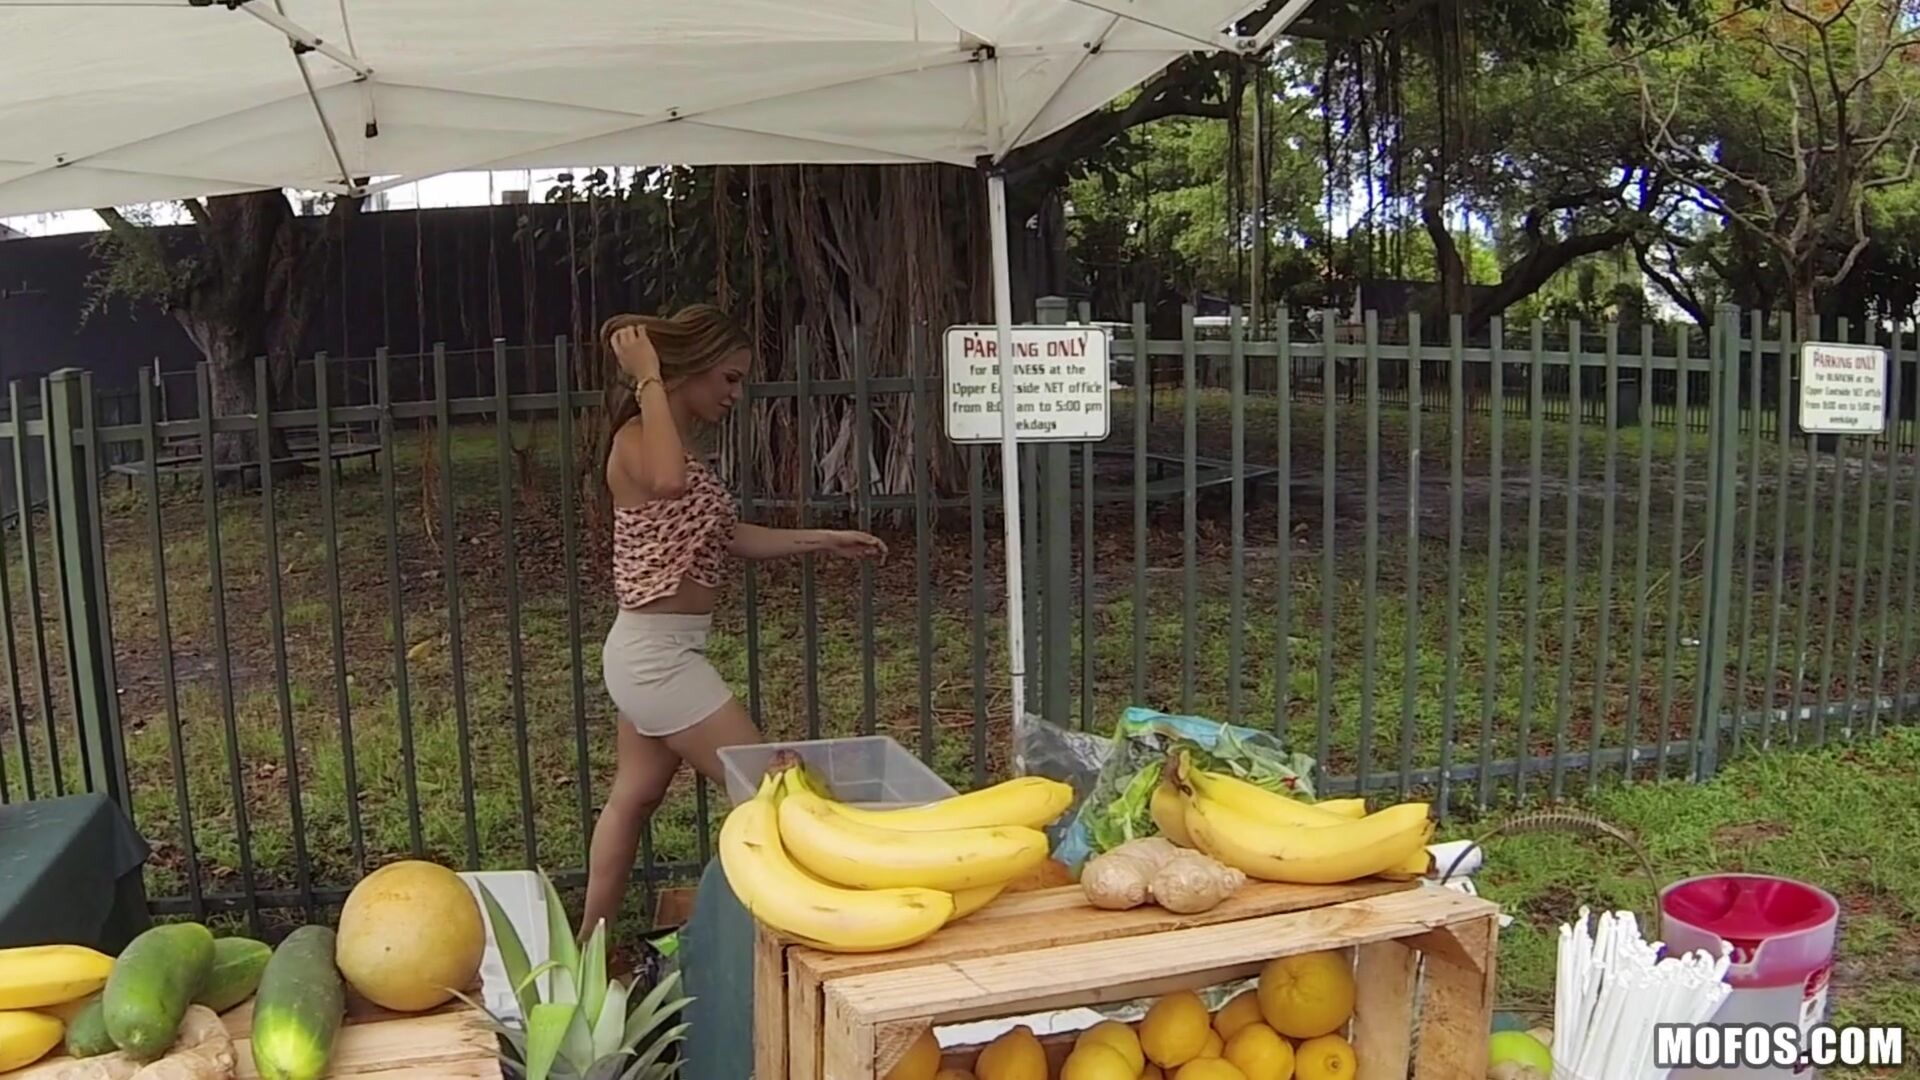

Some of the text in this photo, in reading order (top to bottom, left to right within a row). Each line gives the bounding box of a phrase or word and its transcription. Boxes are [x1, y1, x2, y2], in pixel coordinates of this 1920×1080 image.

[963, 336, 1087, 358] PARING ONLY
[1813, 351, 1876, 370] PARKING ONLY
[970, 364, 1085, 375] for BINESS at the
[952, 382, 986, 397] Upper
[1044, 382, 1064, 393] NET
[1068, 382, 1103, 394] office
[952, 400, 1103, 414] from 8:0 am to 5:00 pm
[1016, 418, 1057, 433] ekdays
